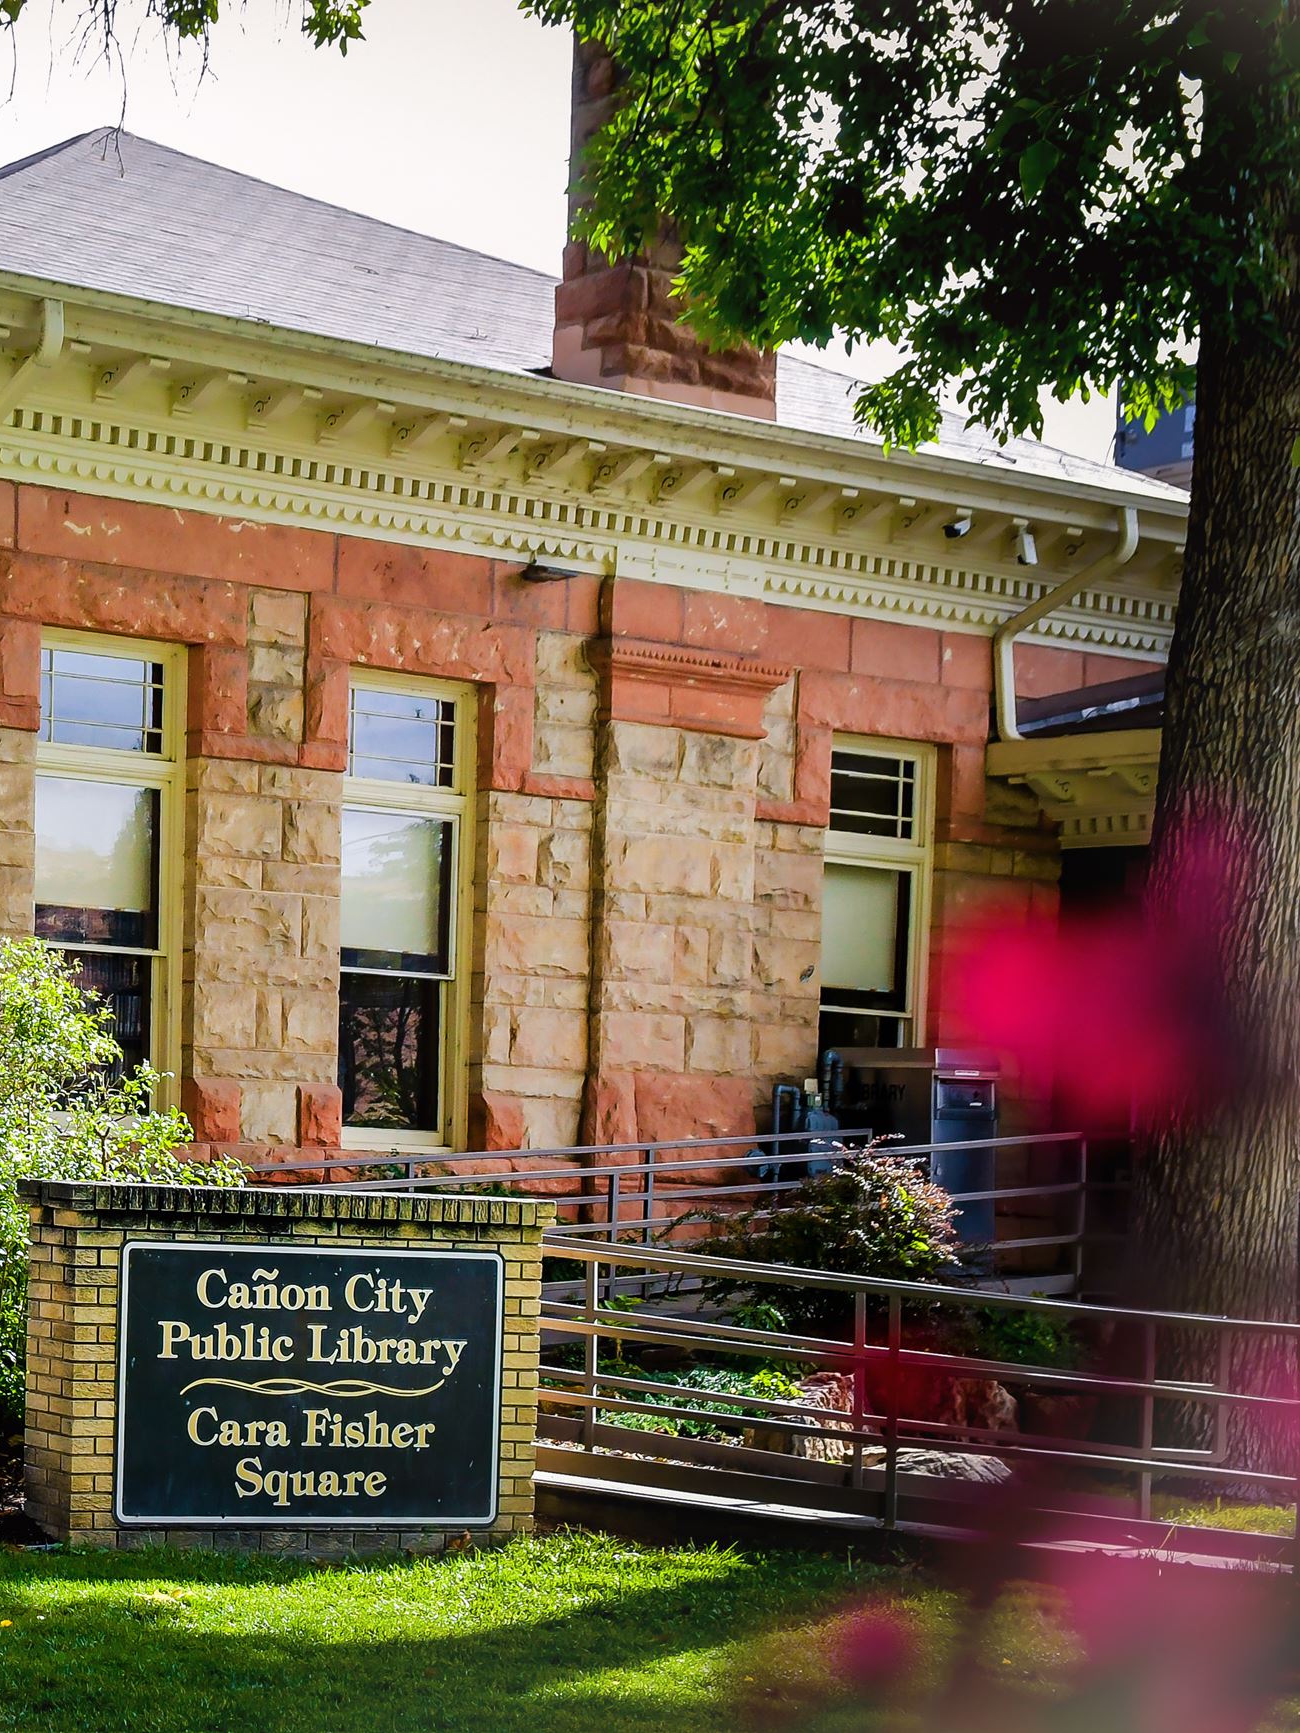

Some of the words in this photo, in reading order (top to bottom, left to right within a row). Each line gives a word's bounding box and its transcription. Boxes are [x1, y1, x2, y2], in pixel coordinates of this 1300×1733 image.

[852, 1083, 905, 1101] BRARY
[197, 1269, 332, 1310] Cañon
[345, 1272, 433, 1324] City
[157, 1321, 294, 1361] Public
[307, 1324, 467, 1375] Library
[187, 1406, 290, 1446] Cara
[301, 1408, 435, 1448] Fisher
[235, 1457, 386, 1505] Square
